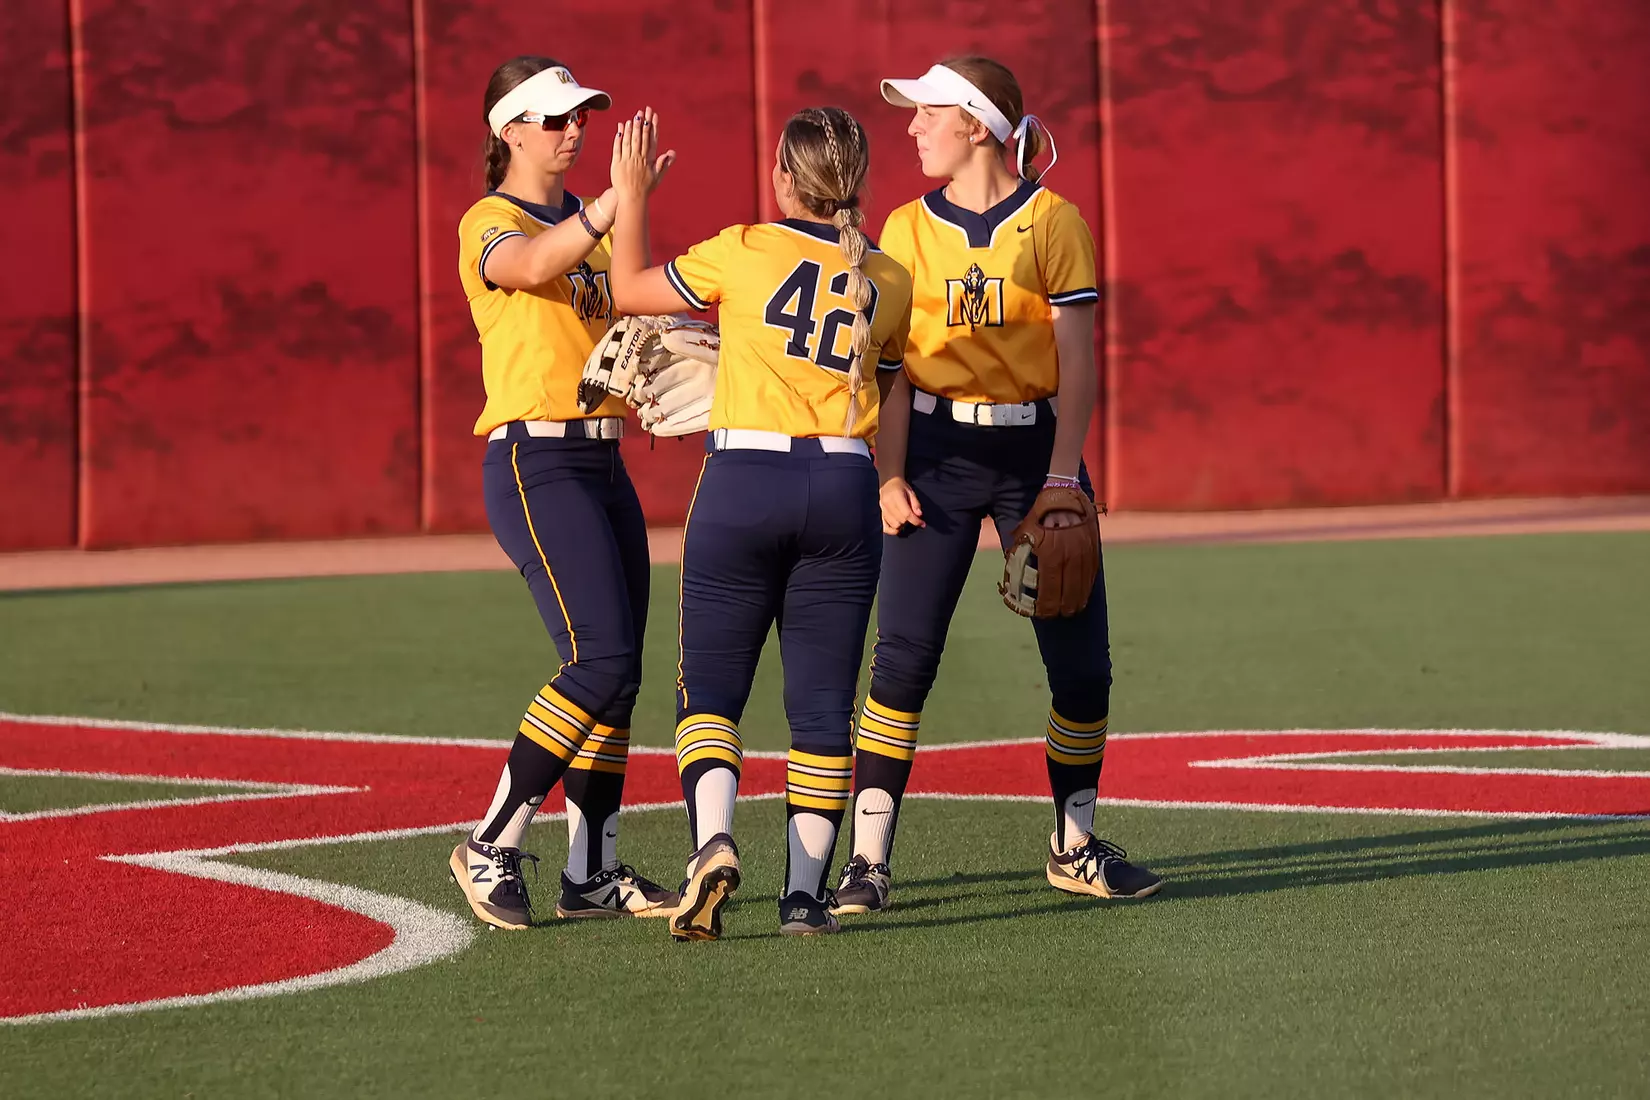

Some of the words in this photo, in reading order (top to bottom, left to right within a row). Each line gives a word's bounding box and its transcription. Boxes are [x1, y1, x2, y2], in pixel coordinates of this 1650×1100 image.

[764, 258, 880, 374] 42
[944, 277, 1005, 328] M
[620, 327, 643, 371] EASTON
[470, 864, 493, 884] N
[601, 885, 635, 910] N
[787, 907, 809, 920] NB
